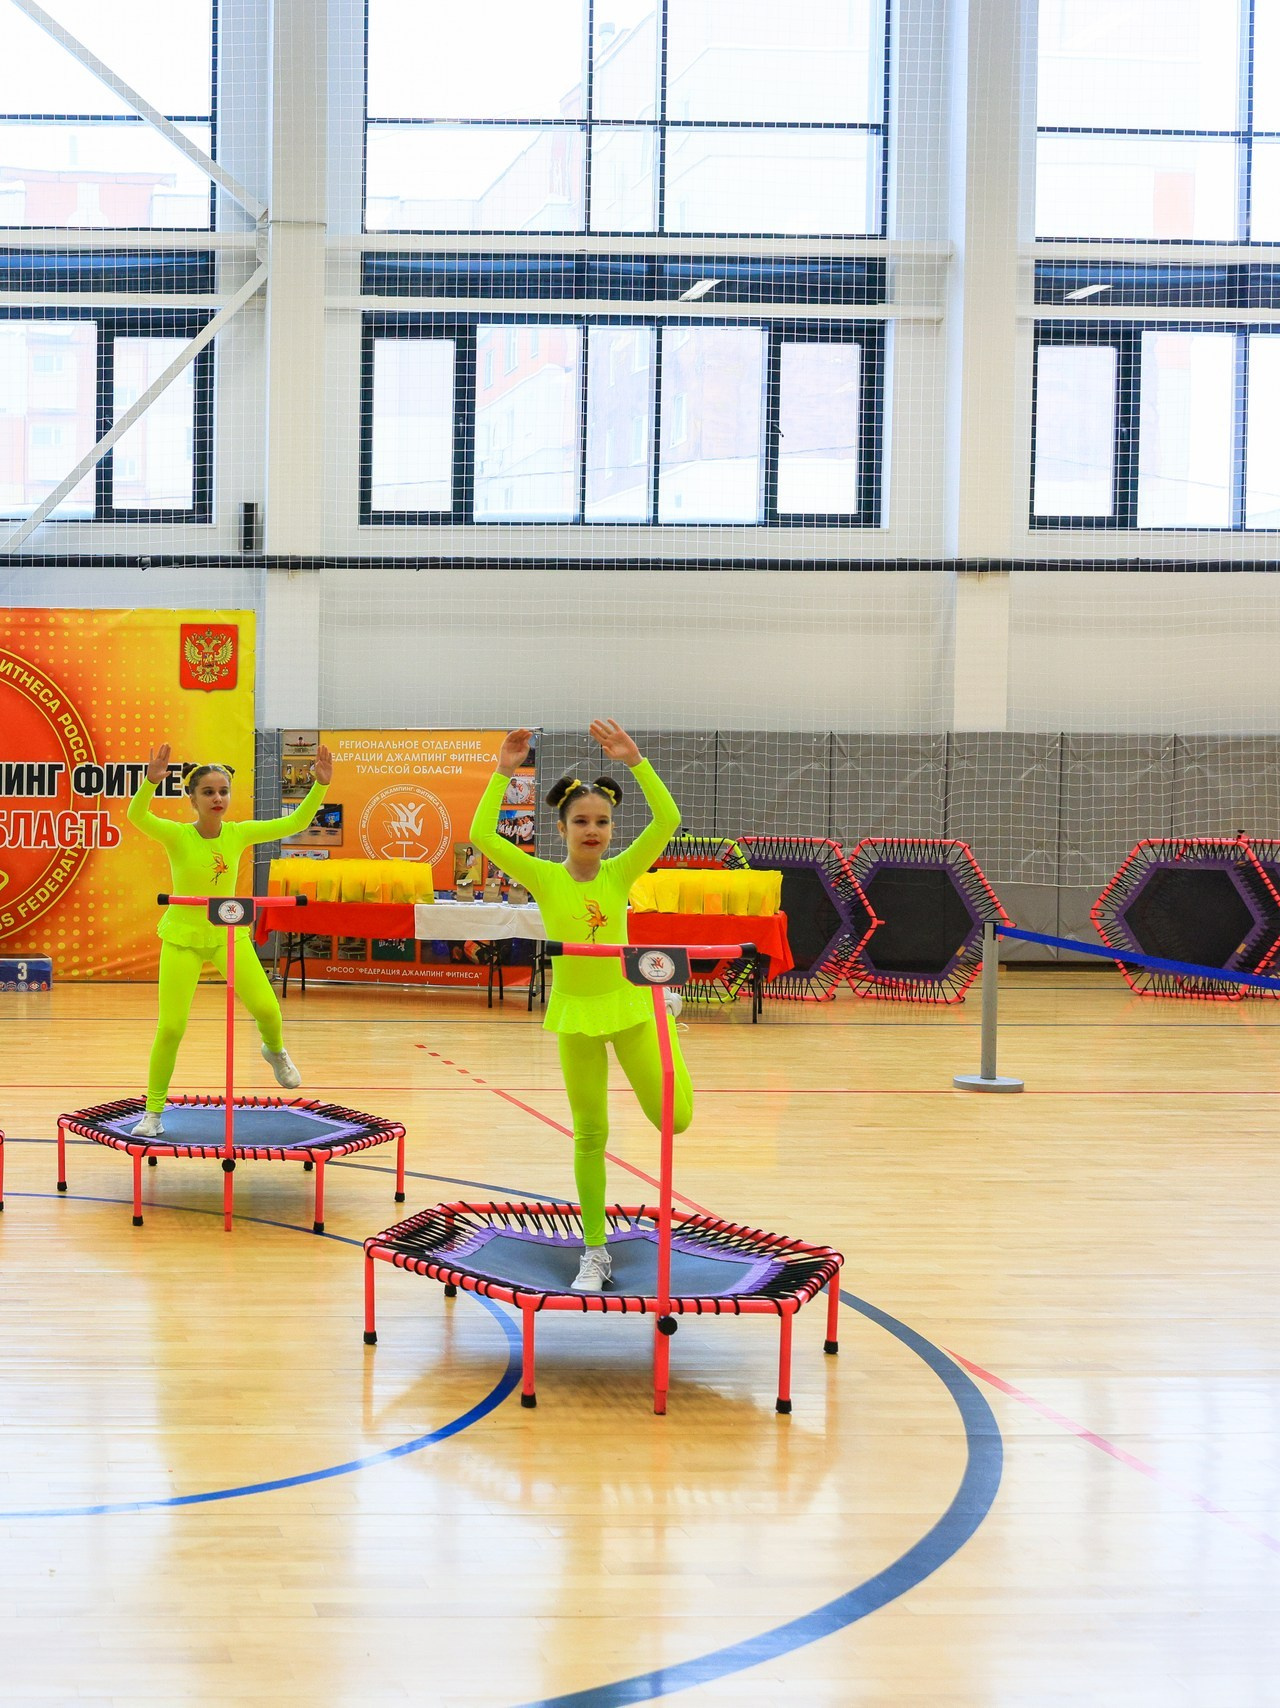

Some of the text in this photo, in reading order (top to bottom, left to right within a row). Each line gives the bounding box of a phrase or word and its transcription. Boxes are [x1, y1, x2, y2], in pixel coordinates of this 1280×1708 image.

[57, 712, 88, 766] РОСС
[339, 740, 481, 750] РЕГИОНАЛЬНОЕ ОТДЕЛЕНИЕ
[331, 753, 498, 763] ЕДЕРАЦИИ ДЖАМПИНГ ФИТНЕСА
[356, 764, 463, 775] ТУЛЬСКОЙ ОБЛАСТИ
[17, 962, 28, 981] 3
[326, 966, 354, 974] ОФСОО
[402, 969, 445, 978] ДЖАМПИНГ
